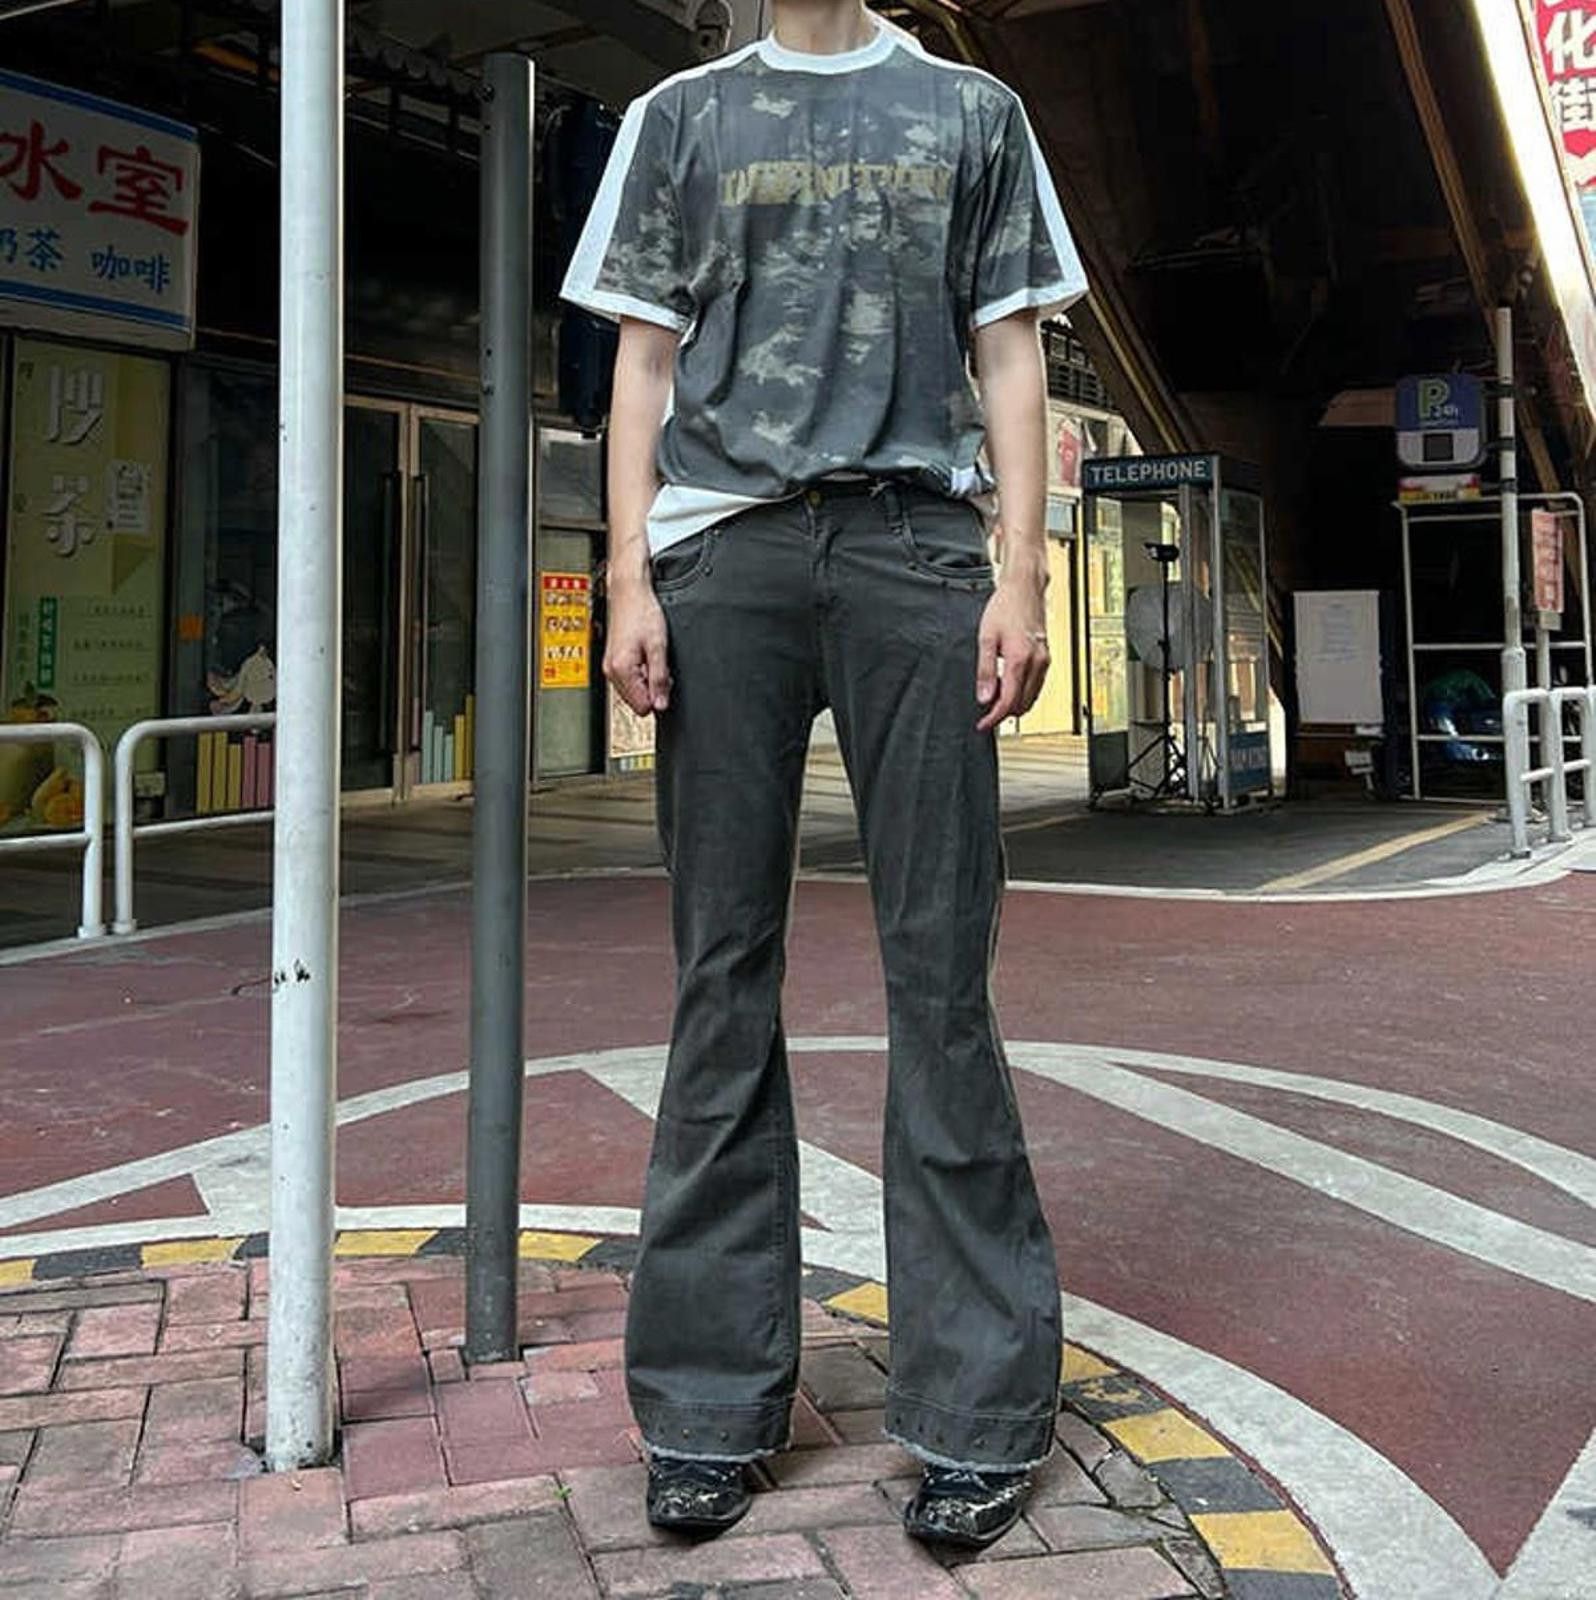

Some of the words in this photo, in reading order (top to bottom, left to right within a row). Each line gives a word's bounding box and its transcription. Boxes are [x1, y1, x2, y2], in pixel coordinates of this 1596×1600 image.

[90, 243, 171, 294] 咖啡
[1417, 378, 1450, 419] P
[1090, 460, 1206, 483] TELEPHONE
